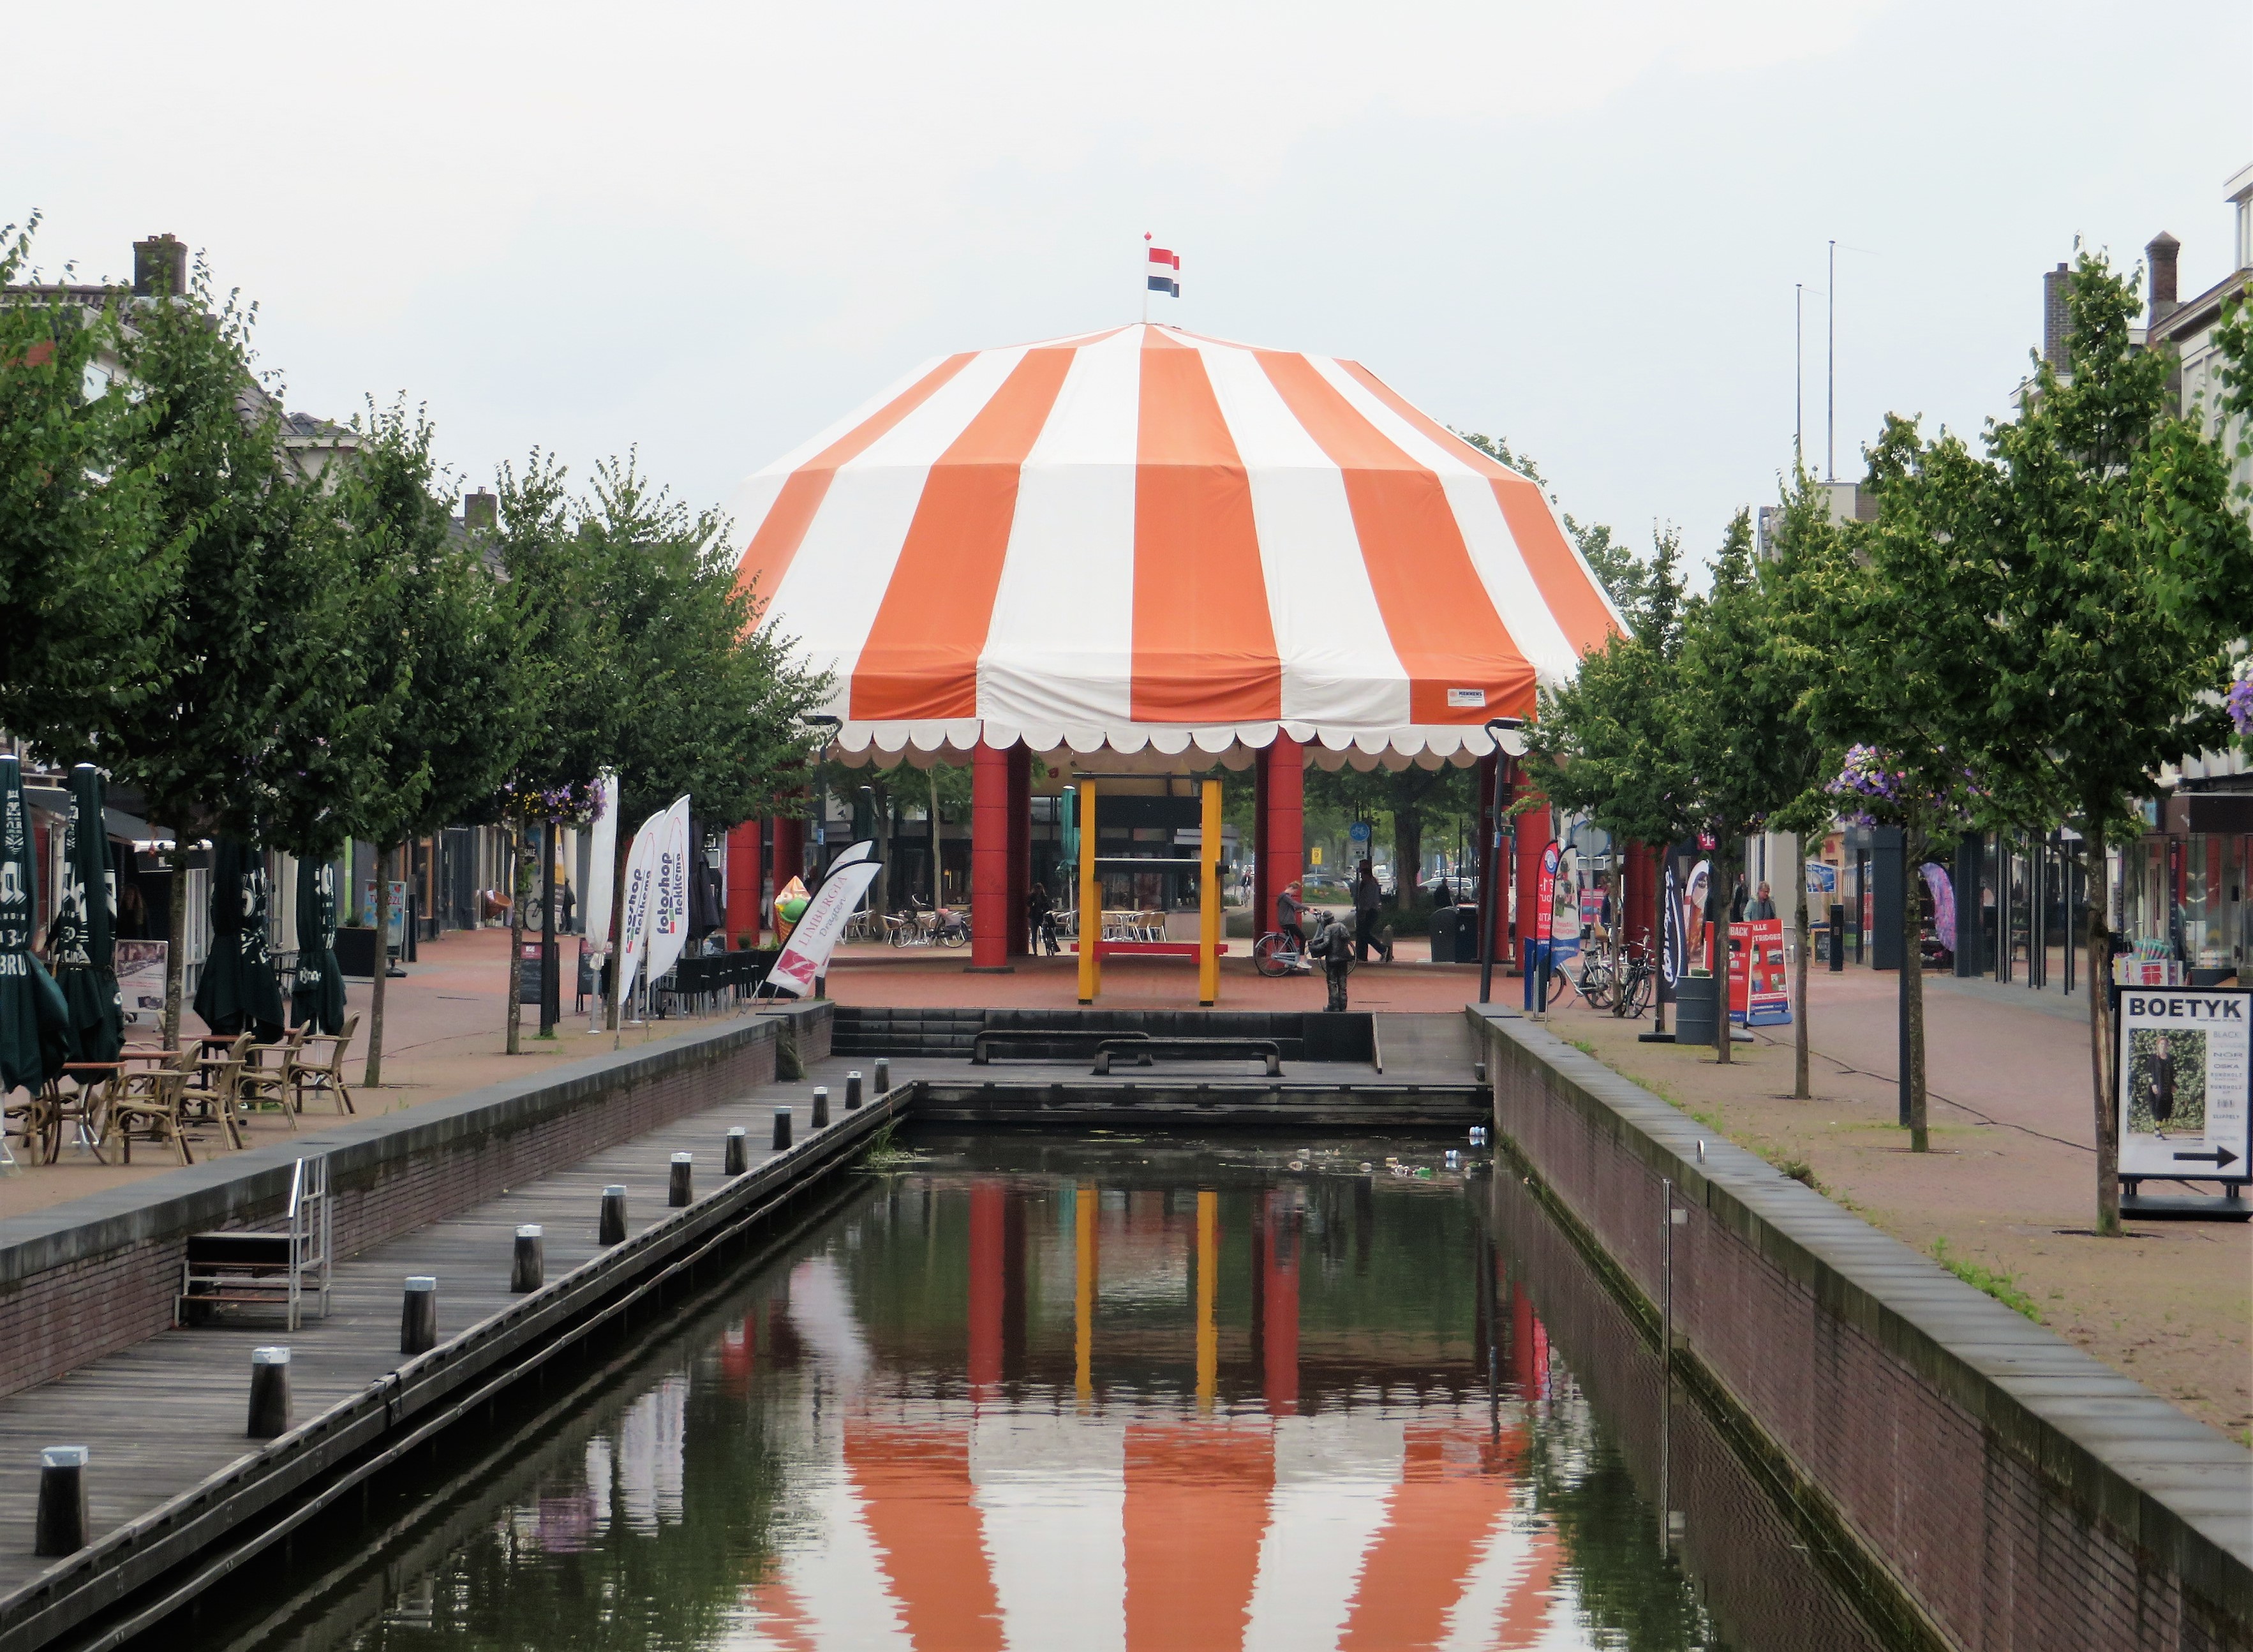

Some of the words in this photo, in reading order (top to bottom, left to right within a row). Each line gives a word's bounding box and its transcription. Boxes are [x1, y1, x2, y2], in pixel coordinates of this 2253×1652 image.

[657, 852, 672, 934] fotoshop
[673, 853, 683, 915] Bekkema
[799, 876, 847, 946] LIMBURGIA
[1729, 926, 1748, 937] BACK
[1754, 934, 1781, 942] TRIDGES
[2129, 998, 2242, 1018] BOETYK
